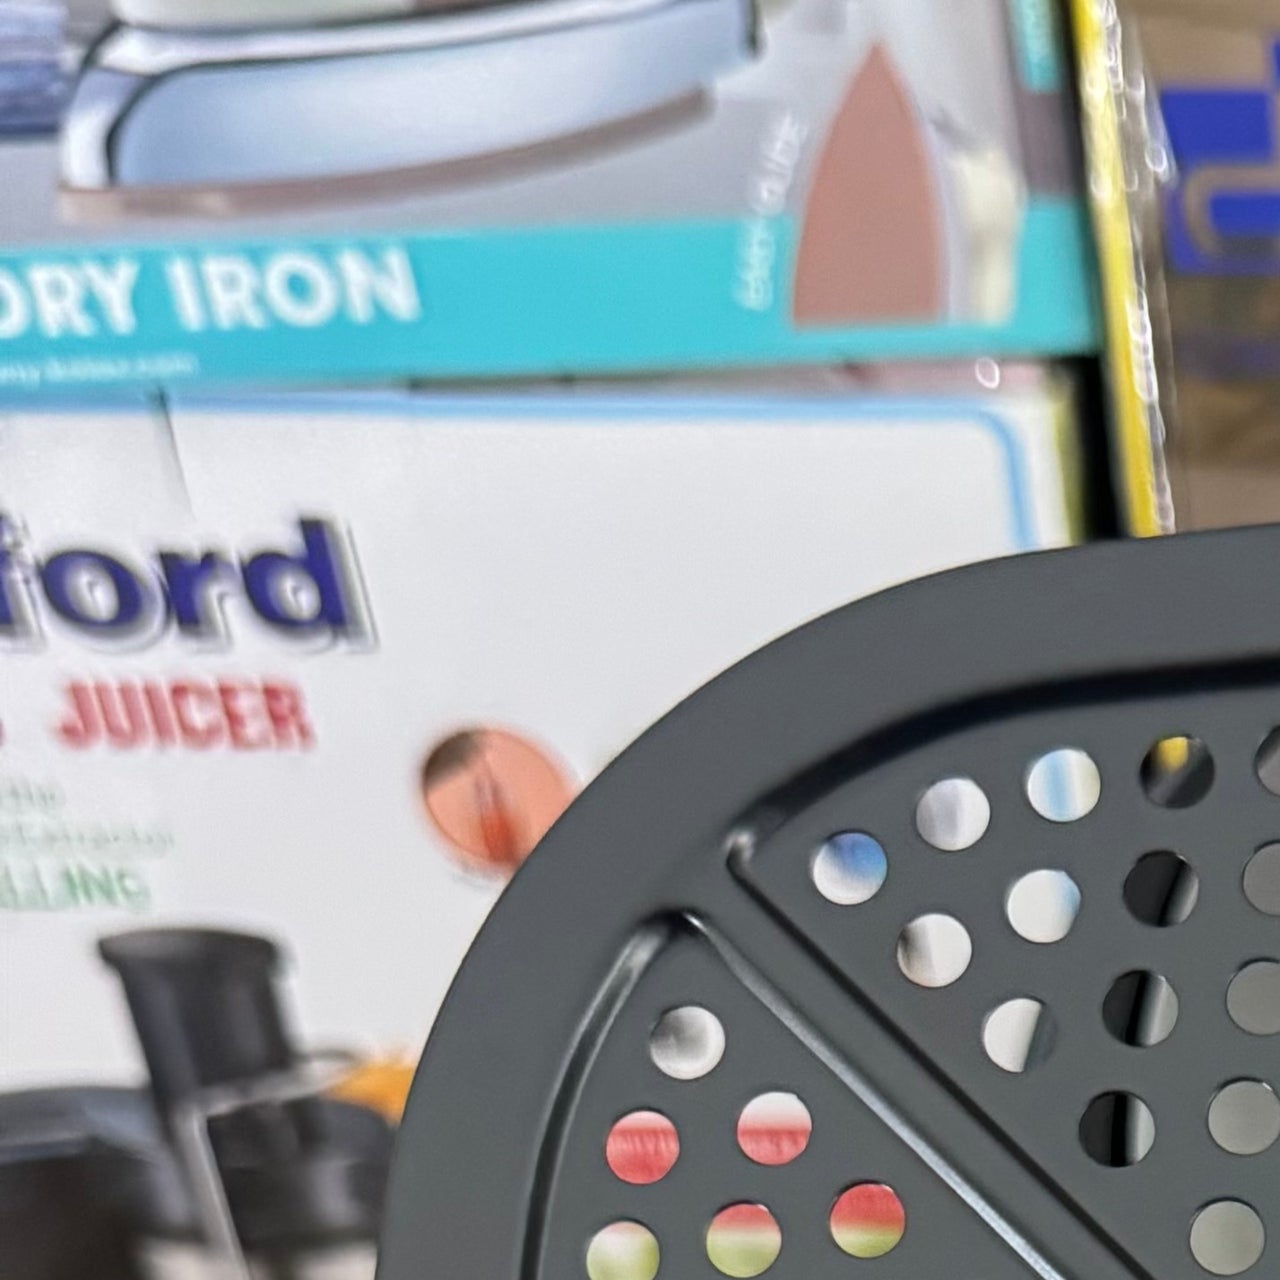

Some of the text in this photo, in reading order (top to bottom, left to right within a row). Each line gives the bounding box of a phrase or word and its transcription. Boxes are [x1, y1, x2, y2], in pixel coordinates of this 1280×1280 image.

[0, 248, 420, 338] DRY IRON
[56, 676, 314, 750] JUICER
